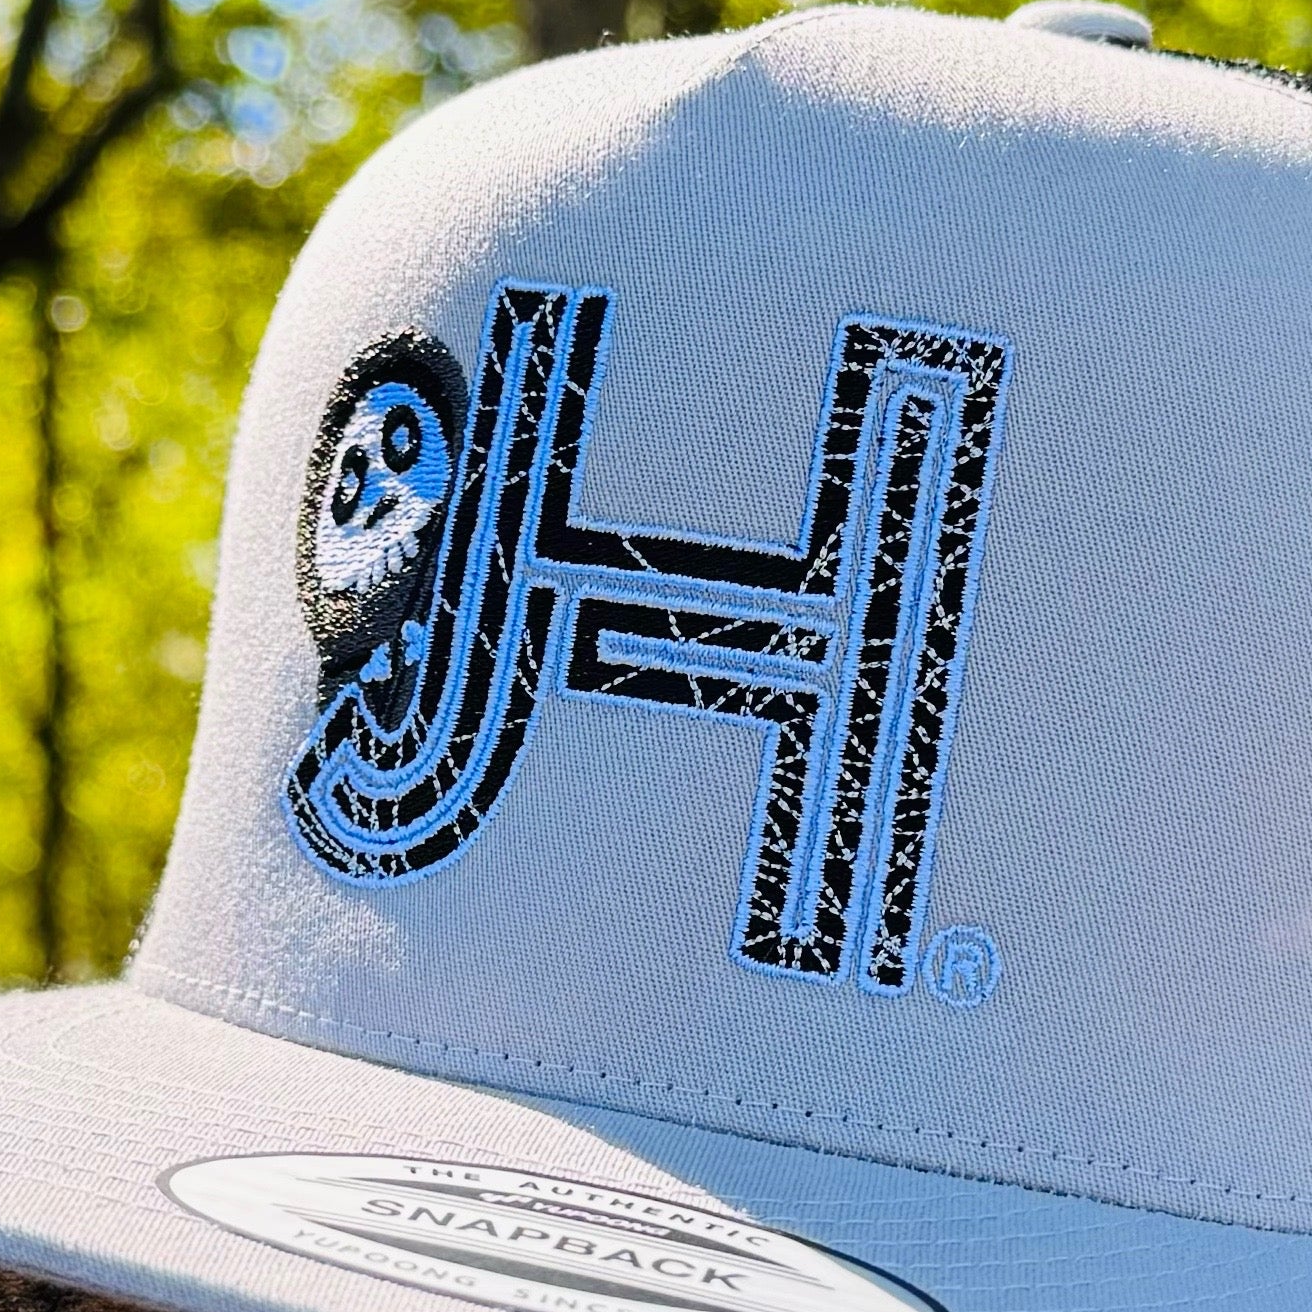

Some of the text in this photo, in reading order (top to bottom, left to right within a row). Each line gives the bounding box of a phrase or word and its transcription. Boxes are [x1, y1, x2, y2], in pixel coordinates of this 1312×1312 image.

[361, 1198, 749, 1291] SNAPBACK
[403, 1165, 771, 1247] THE AUTHENTIC
[294, 1229, 479, 1288] YUPOONG
